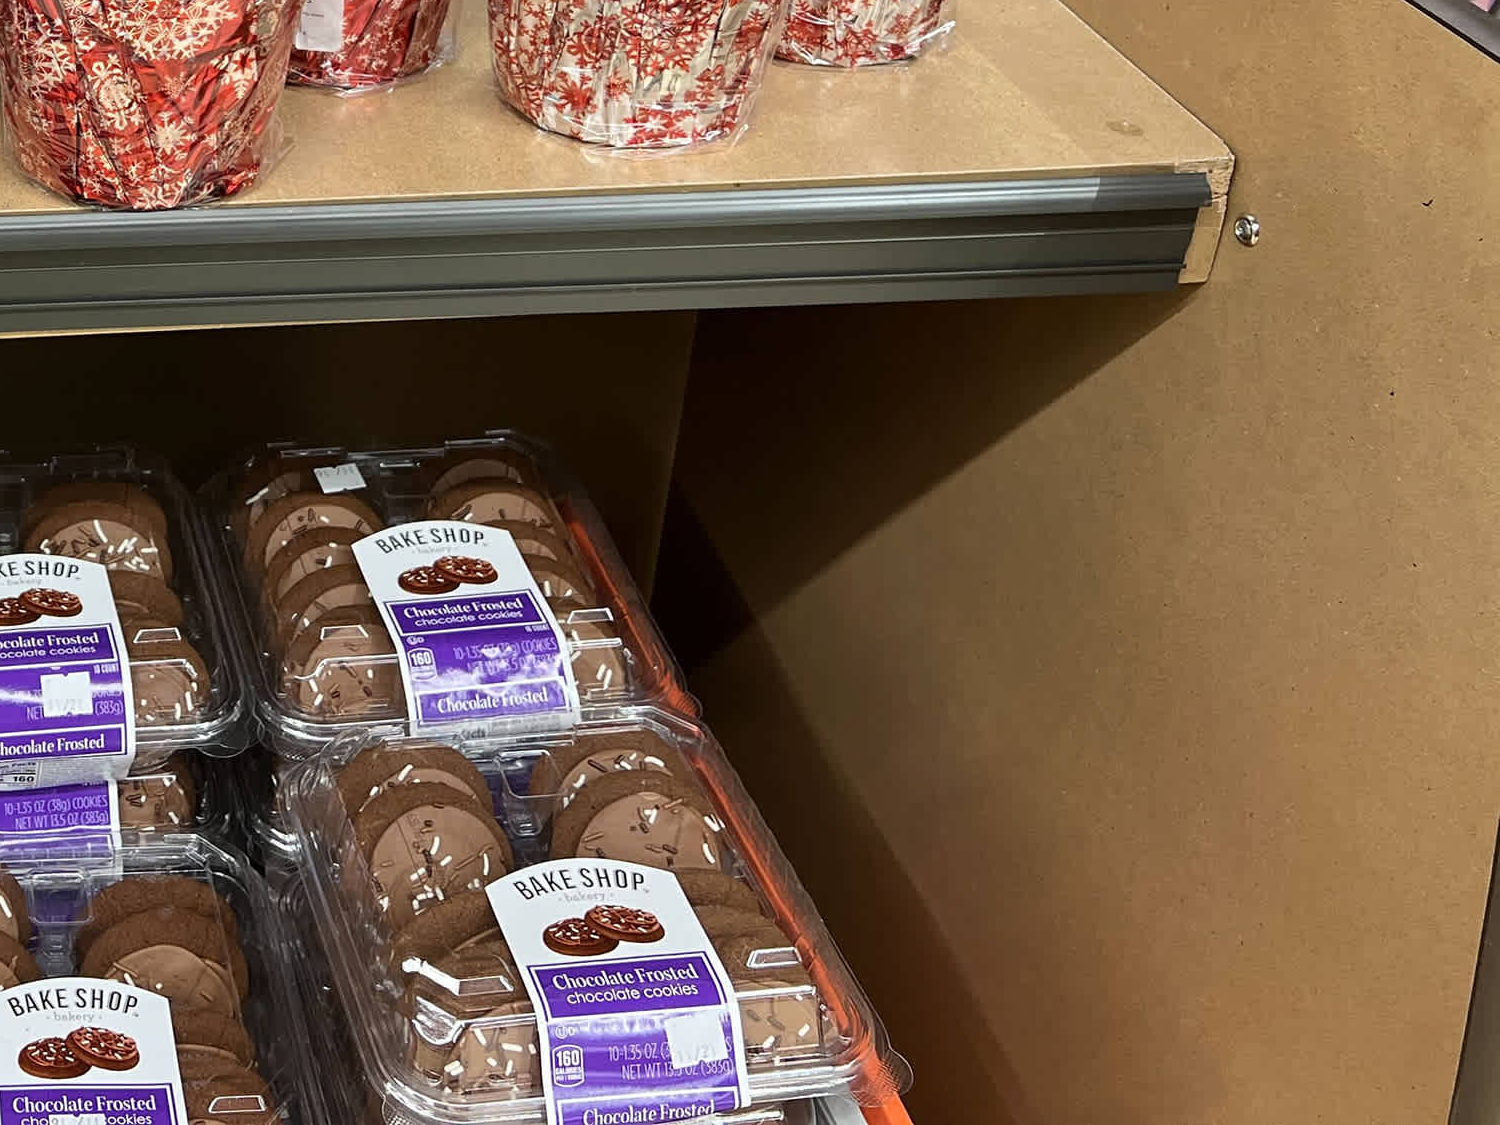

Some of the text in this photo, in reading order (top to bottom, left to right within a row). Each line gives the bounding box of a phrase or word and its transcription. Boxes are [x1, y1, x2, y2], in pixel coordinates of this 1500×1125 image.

[376, 528, 484, 554] BAKE SHOP
[25, 561, 79, 578] SHOP
[403, 597, 523, 619] Chocolate Frosted
[415, 610, 523, 627] chocolate cookies
[48, 632, 99, 646] Frosted
[522, 637, 558, 653] COOKIES
[49, 644, 96, 656] cookies
[411, 651, 431, 666] 160
[95, 701, 124, 716] (383g)
[437, 686, 549, 714] Chocolate Frosted
[57, 733, 105, 751] Frosted
[35, 800, 45, 812] OZ
[72, 795, 108, 809] COOKIES
[15, 817, 33, 829] NET
[35, 816, 48, 827] WT
[513, 867, 645, 900] BAKE SHOP
[552, 963, 699, 990] Chocolate Frosted
[7, 988, 139, 1017] BAKE SHOP
[566, 983, 698, 1005] chocolate cookies
[54, 1011, 96, 1023] bakery
[555, 1050, 580, 1067] 160
[608, 1042, 659, 1062] 10-1.35 OZ
[622, 1063, 642, 1081] NET
[644, 1062, 661, 1079] WT
[12, 1094, 156, 1113] Chocolate Frosted
[583, 1099, 715, 1125] Chocolate Frosted
